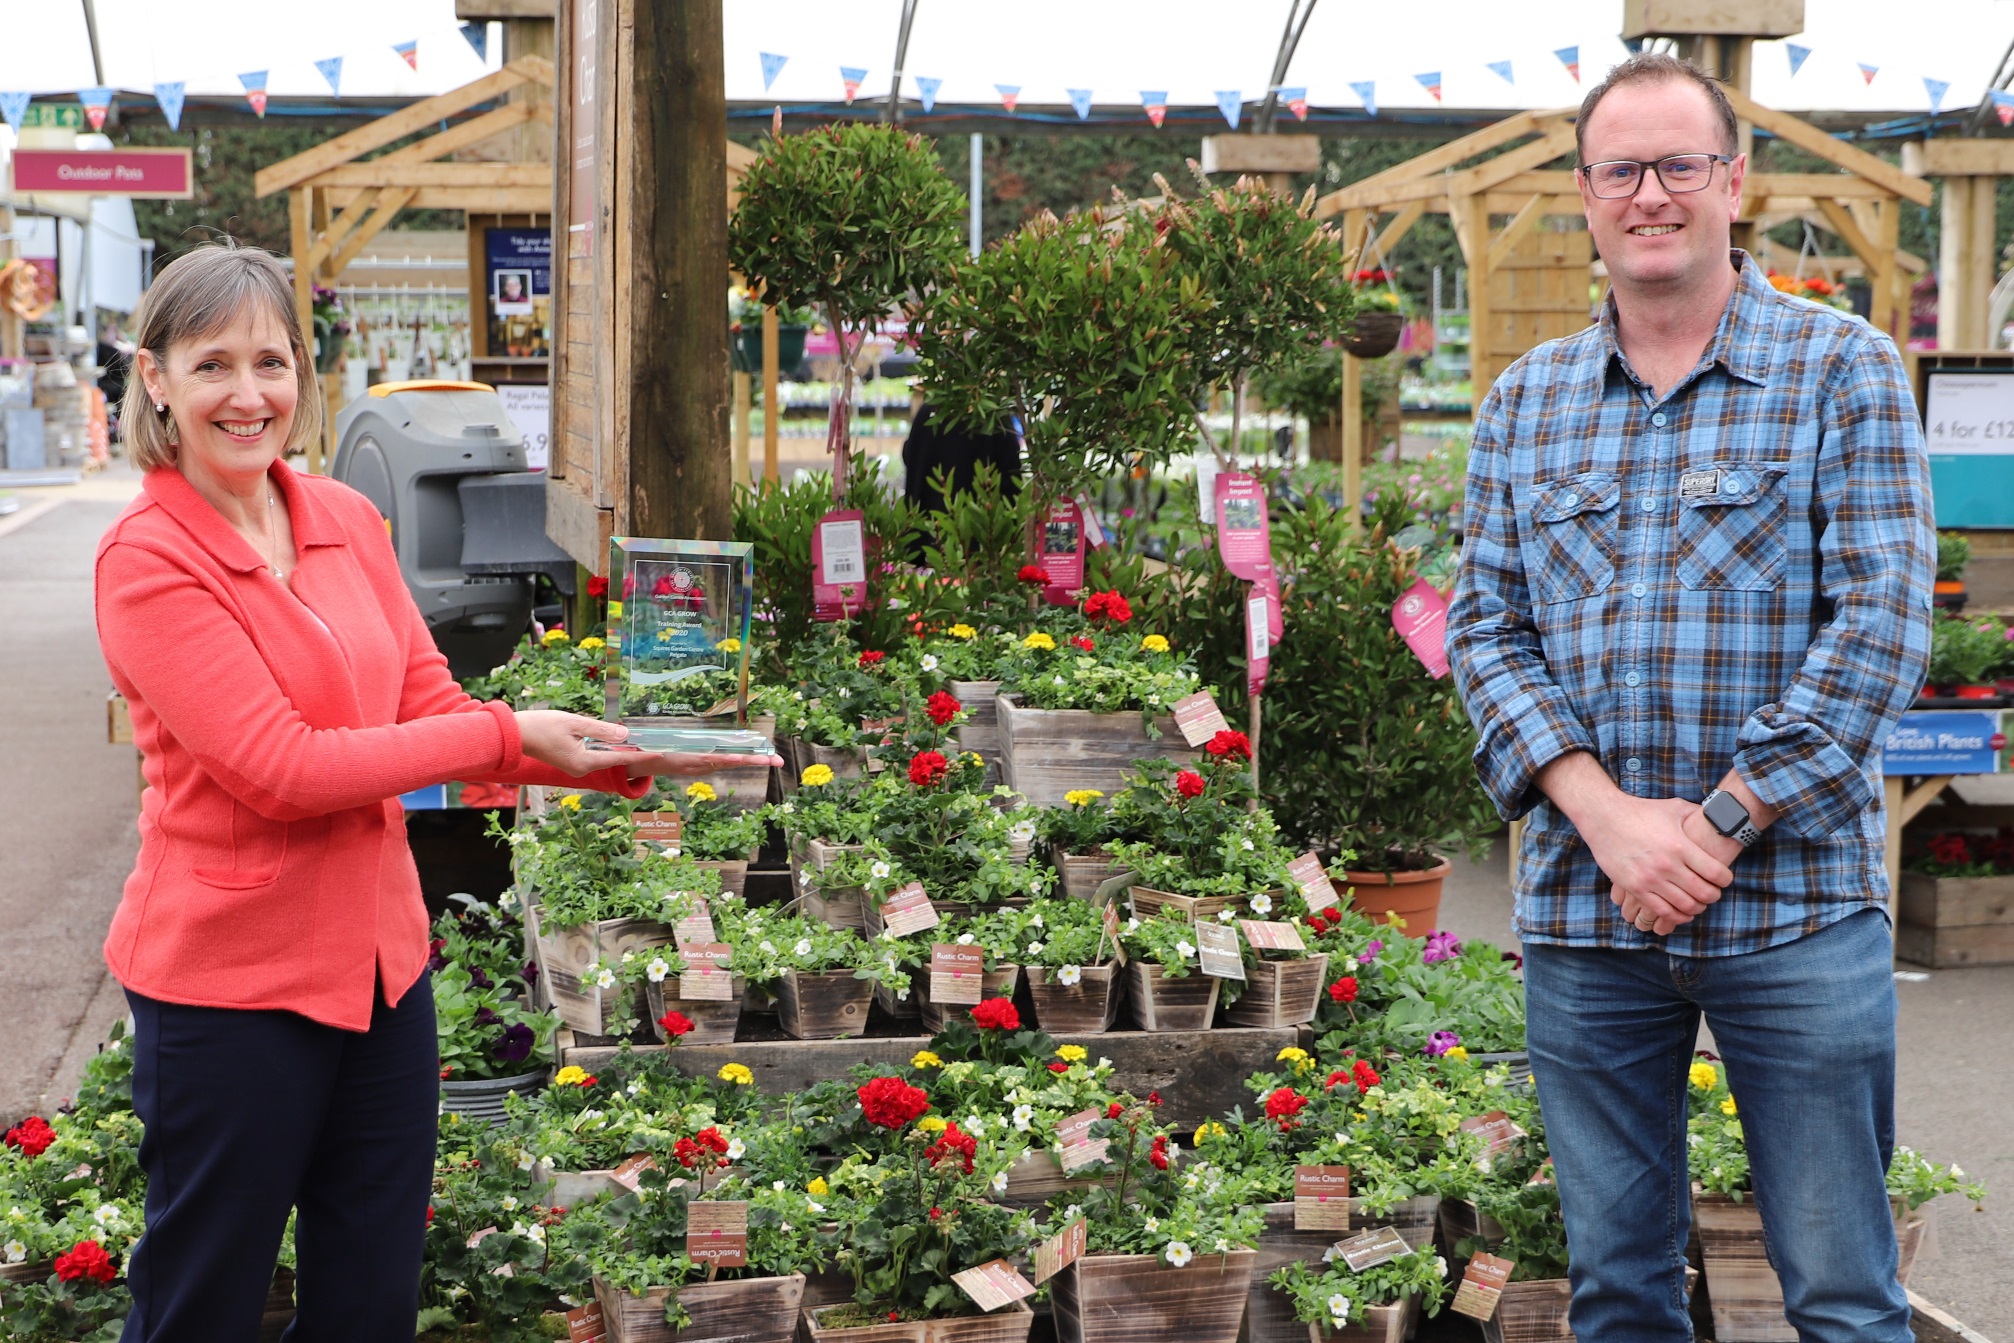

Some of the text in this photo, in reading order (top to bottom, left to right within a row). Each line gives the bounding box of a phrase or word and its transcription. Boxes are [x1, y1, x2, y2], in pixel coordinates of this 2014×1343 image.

[57, 164, 113, 180] Outdoor
[1932, 421, 1944, 438] 4
[1950, 420, 1977, 438] for
[1229, 488, 1252, 496] Impact
[657, 621, 682, 629] Training
[670, 629, 689, 637] 2020
[1885, 733, 1936, 751] British
[1937, 733, 1983, 750] Plants
[635, 820, 678, 828] Rustic Charm
[684, 950, 728, 959] Rustic Charm
[936, 951, 980, 961] Rustic Charm
[1217, 947, 1240, 957] Charm
[1300, 1174, 1346, 1183] Rustic Charm
[691, 1249, 741, 1258] Rustic Charm
[1346, 1239, 1401, 1259] Rustic Charm
[1472, 1260, 1489, 1271] Rustic
[1488, 1264, 1507, 1277] Charm
